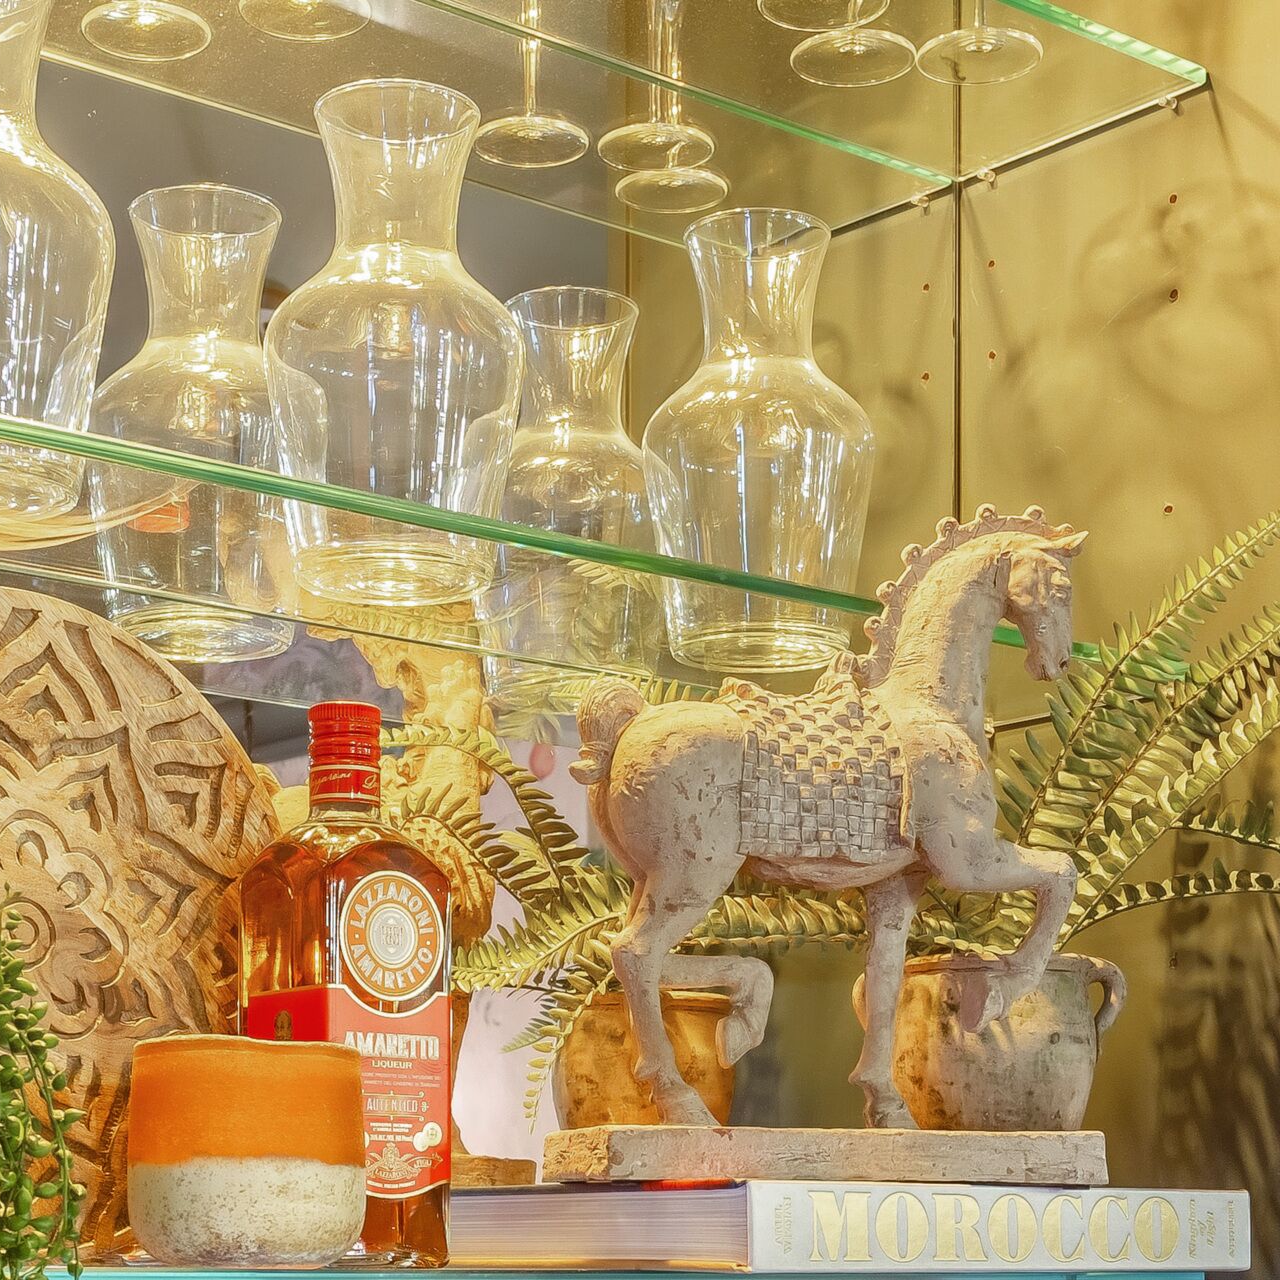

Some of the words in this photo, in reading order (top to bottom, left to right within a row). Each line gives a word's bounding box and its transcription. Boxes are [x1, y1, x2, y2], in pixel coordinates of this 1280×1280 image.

[349, 881, 435, 933] LAZZARONI
[350, 944, 434, 990] AMARETTO
[371, 1060, 413, 1070] LIQUEUR
[807, 1190, 1180, 1263] MOROCCO
